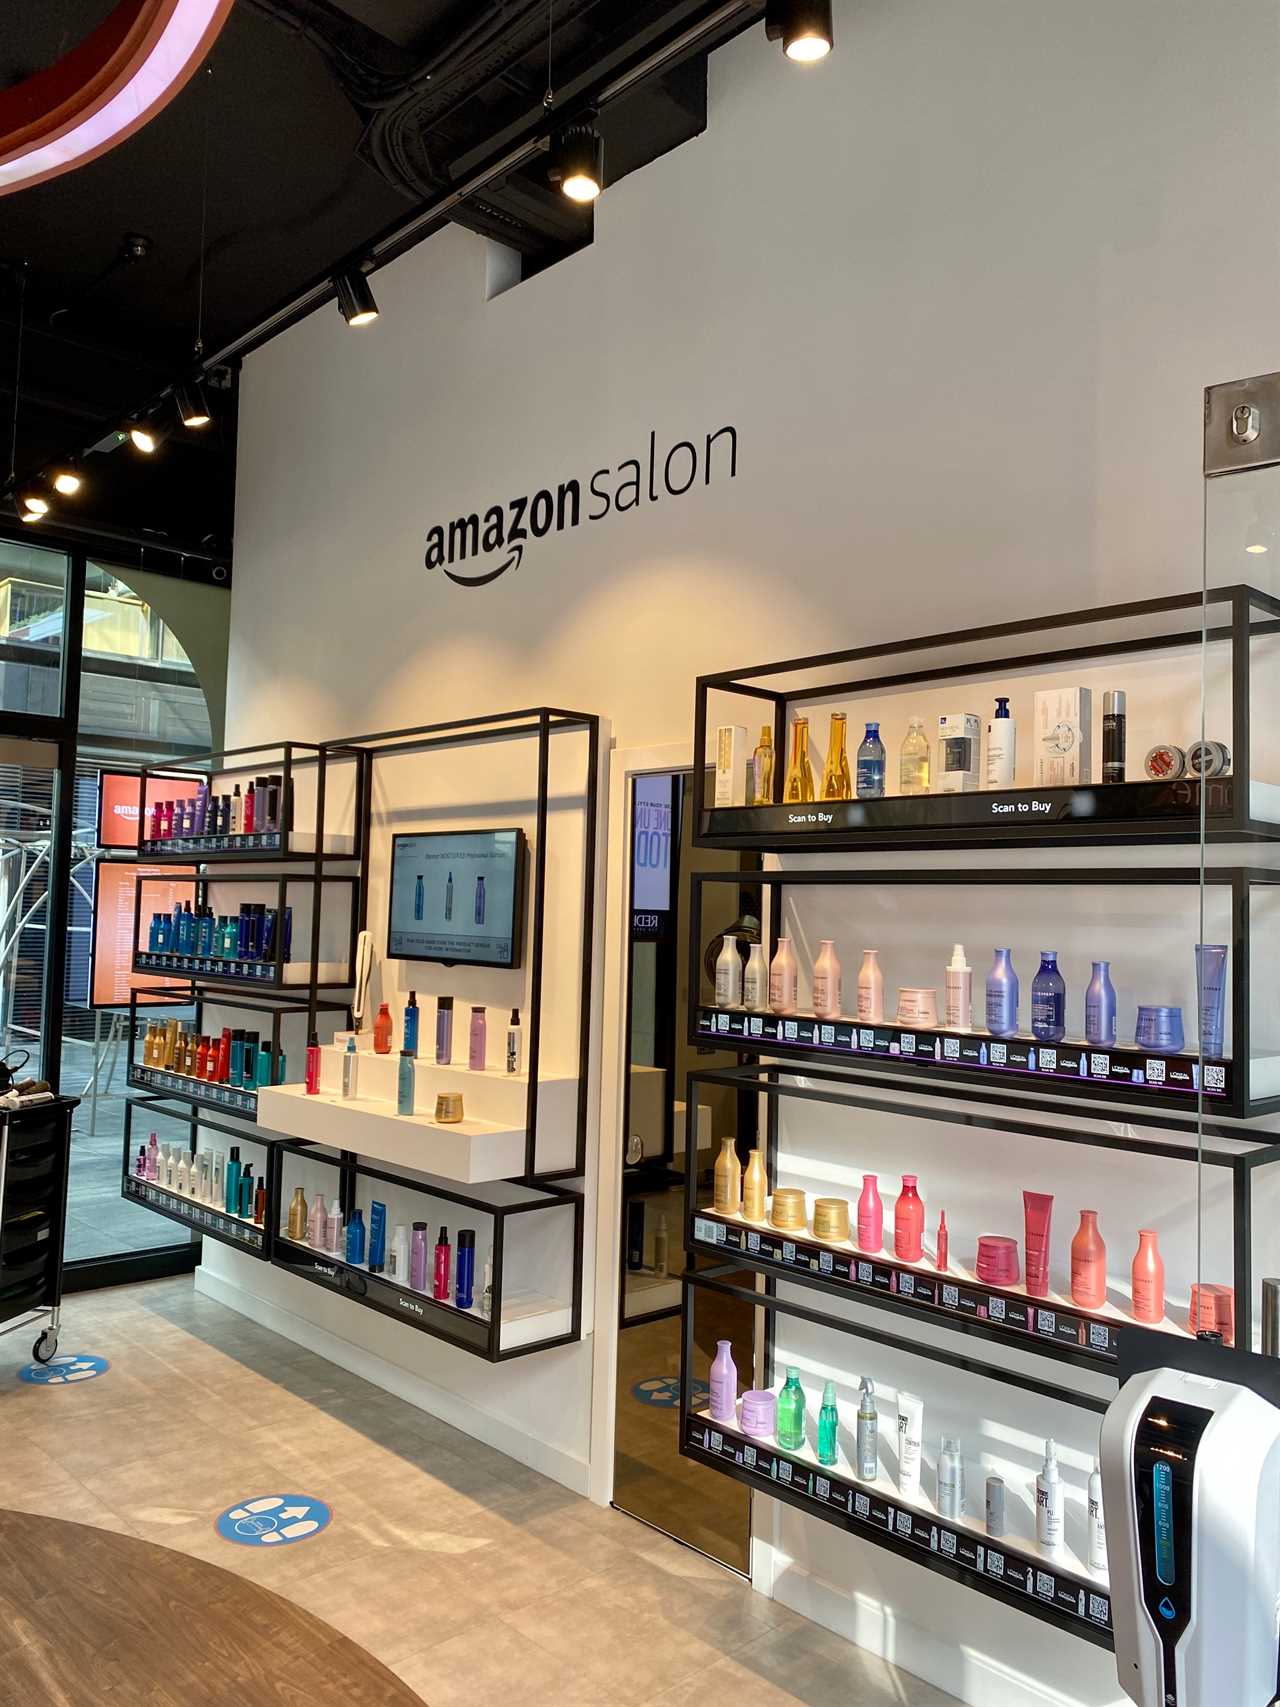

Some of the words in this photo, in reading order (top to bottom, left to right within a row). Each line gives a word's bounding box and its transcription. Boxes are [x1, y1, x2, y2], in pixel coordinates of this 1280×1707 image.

[425, 479, 579, 571] amazon
[588, 425, 737, 521] salon
[992, 803, 1015, 813] Scan
[1017, 803, 1029, 812] to
[1032, 801, 1052, 813] Buy
[788, 814, 806, 823] Scan
[808, 814, 816, 822] to
[818, 812, 833, 824] Buy
